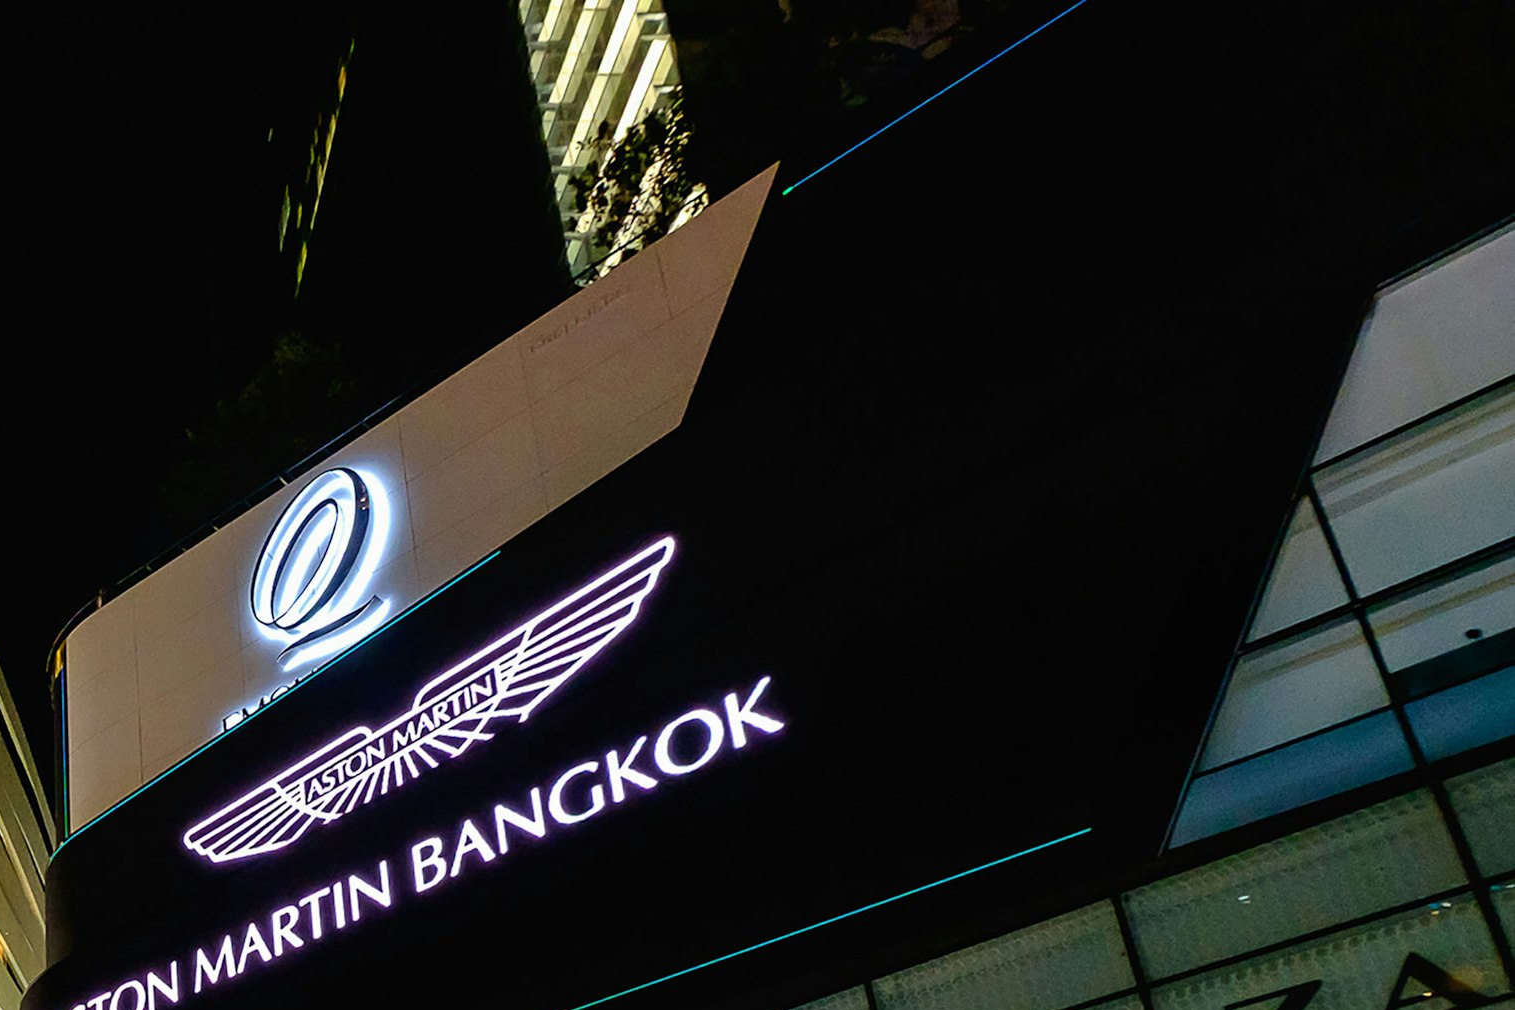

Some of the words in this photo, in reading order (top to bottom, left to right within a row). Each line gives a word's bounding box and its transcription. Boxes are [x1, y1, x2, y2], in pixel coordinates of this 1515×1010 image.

[193, 859, 392, 995] MARTIN
[410, 675, 786, 894] BANGKOK
[307, 737, 386, 803] ASTON
[392, 673, 494, 753] MARTIN
